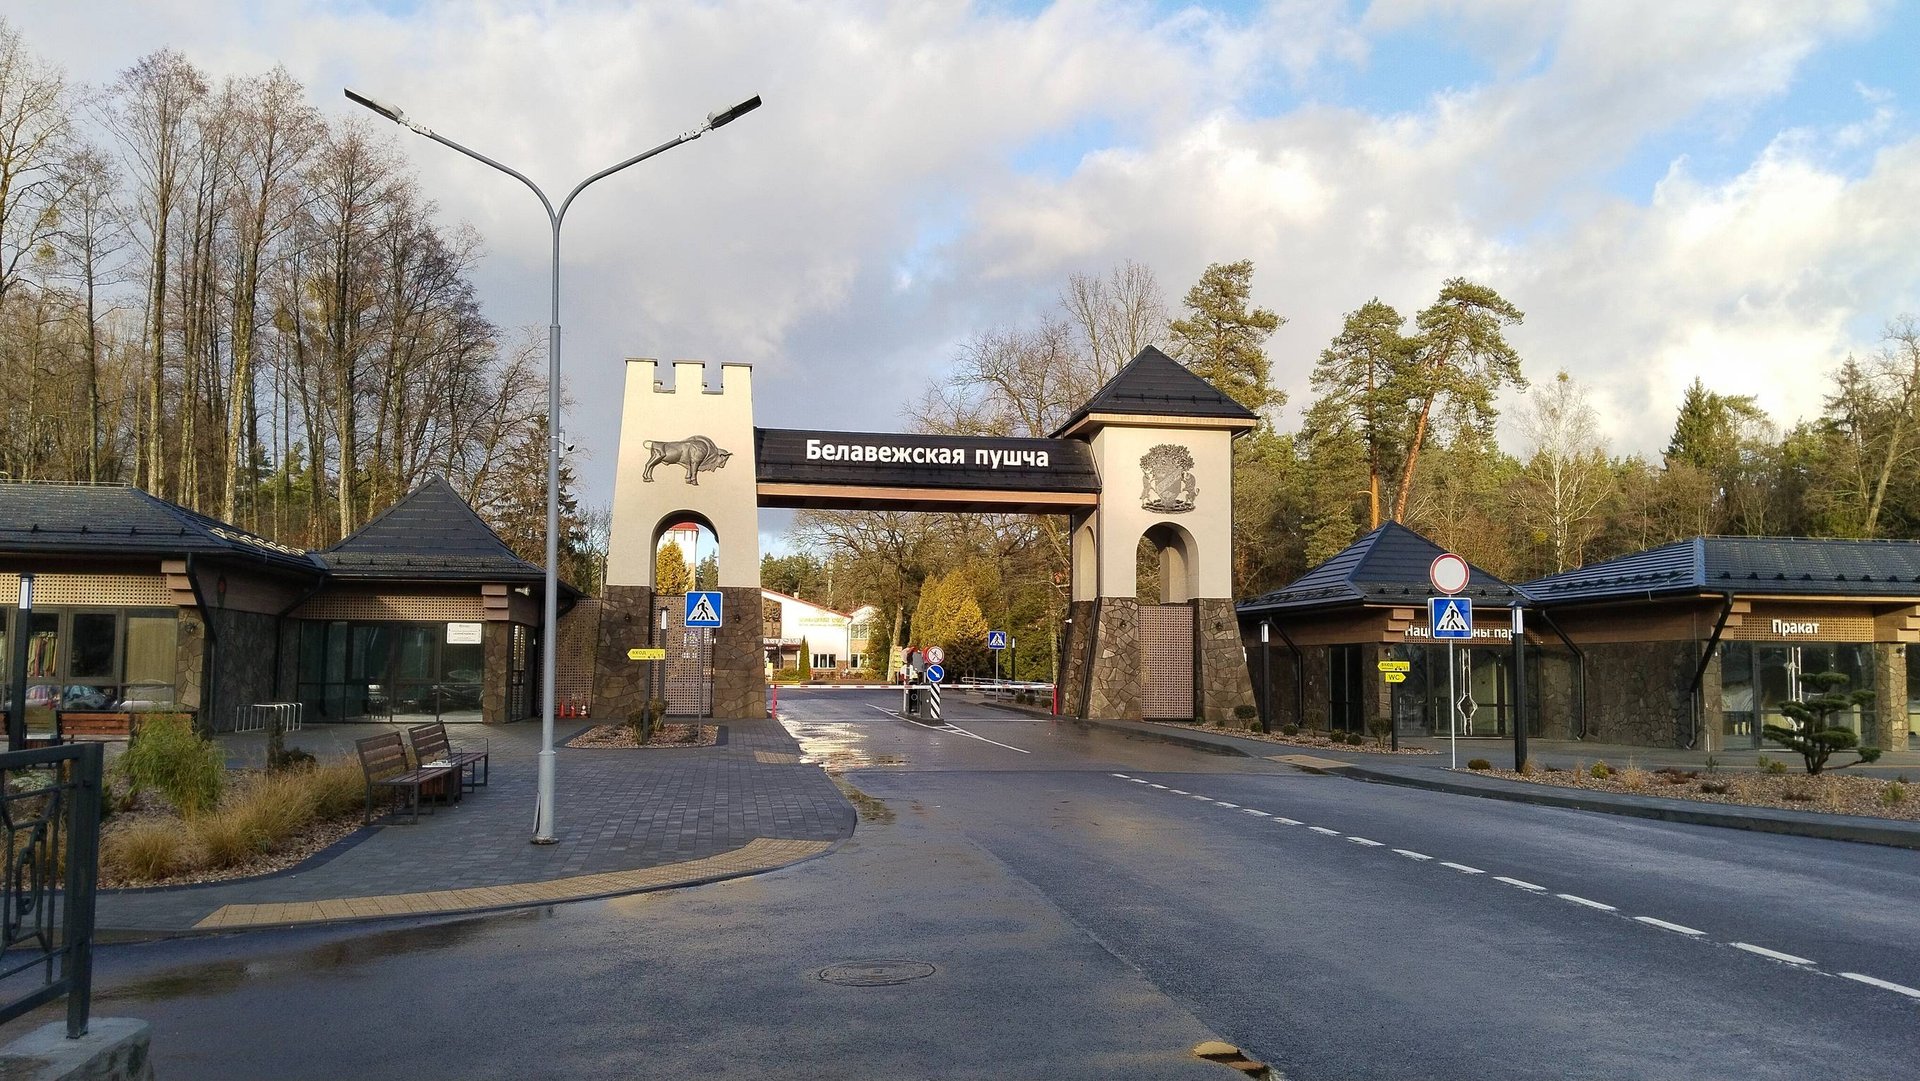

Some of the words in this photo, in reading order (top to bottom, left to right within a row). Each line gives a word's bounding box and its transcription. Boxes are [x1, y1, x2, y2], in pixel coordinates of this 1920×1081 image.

[806, 439, 965, 465] Белавежская
[975, 448, 1049, 469] пушча
[1494, 628, 1513, 641] пар
[1772, 619, 1820, 637] Пракат
